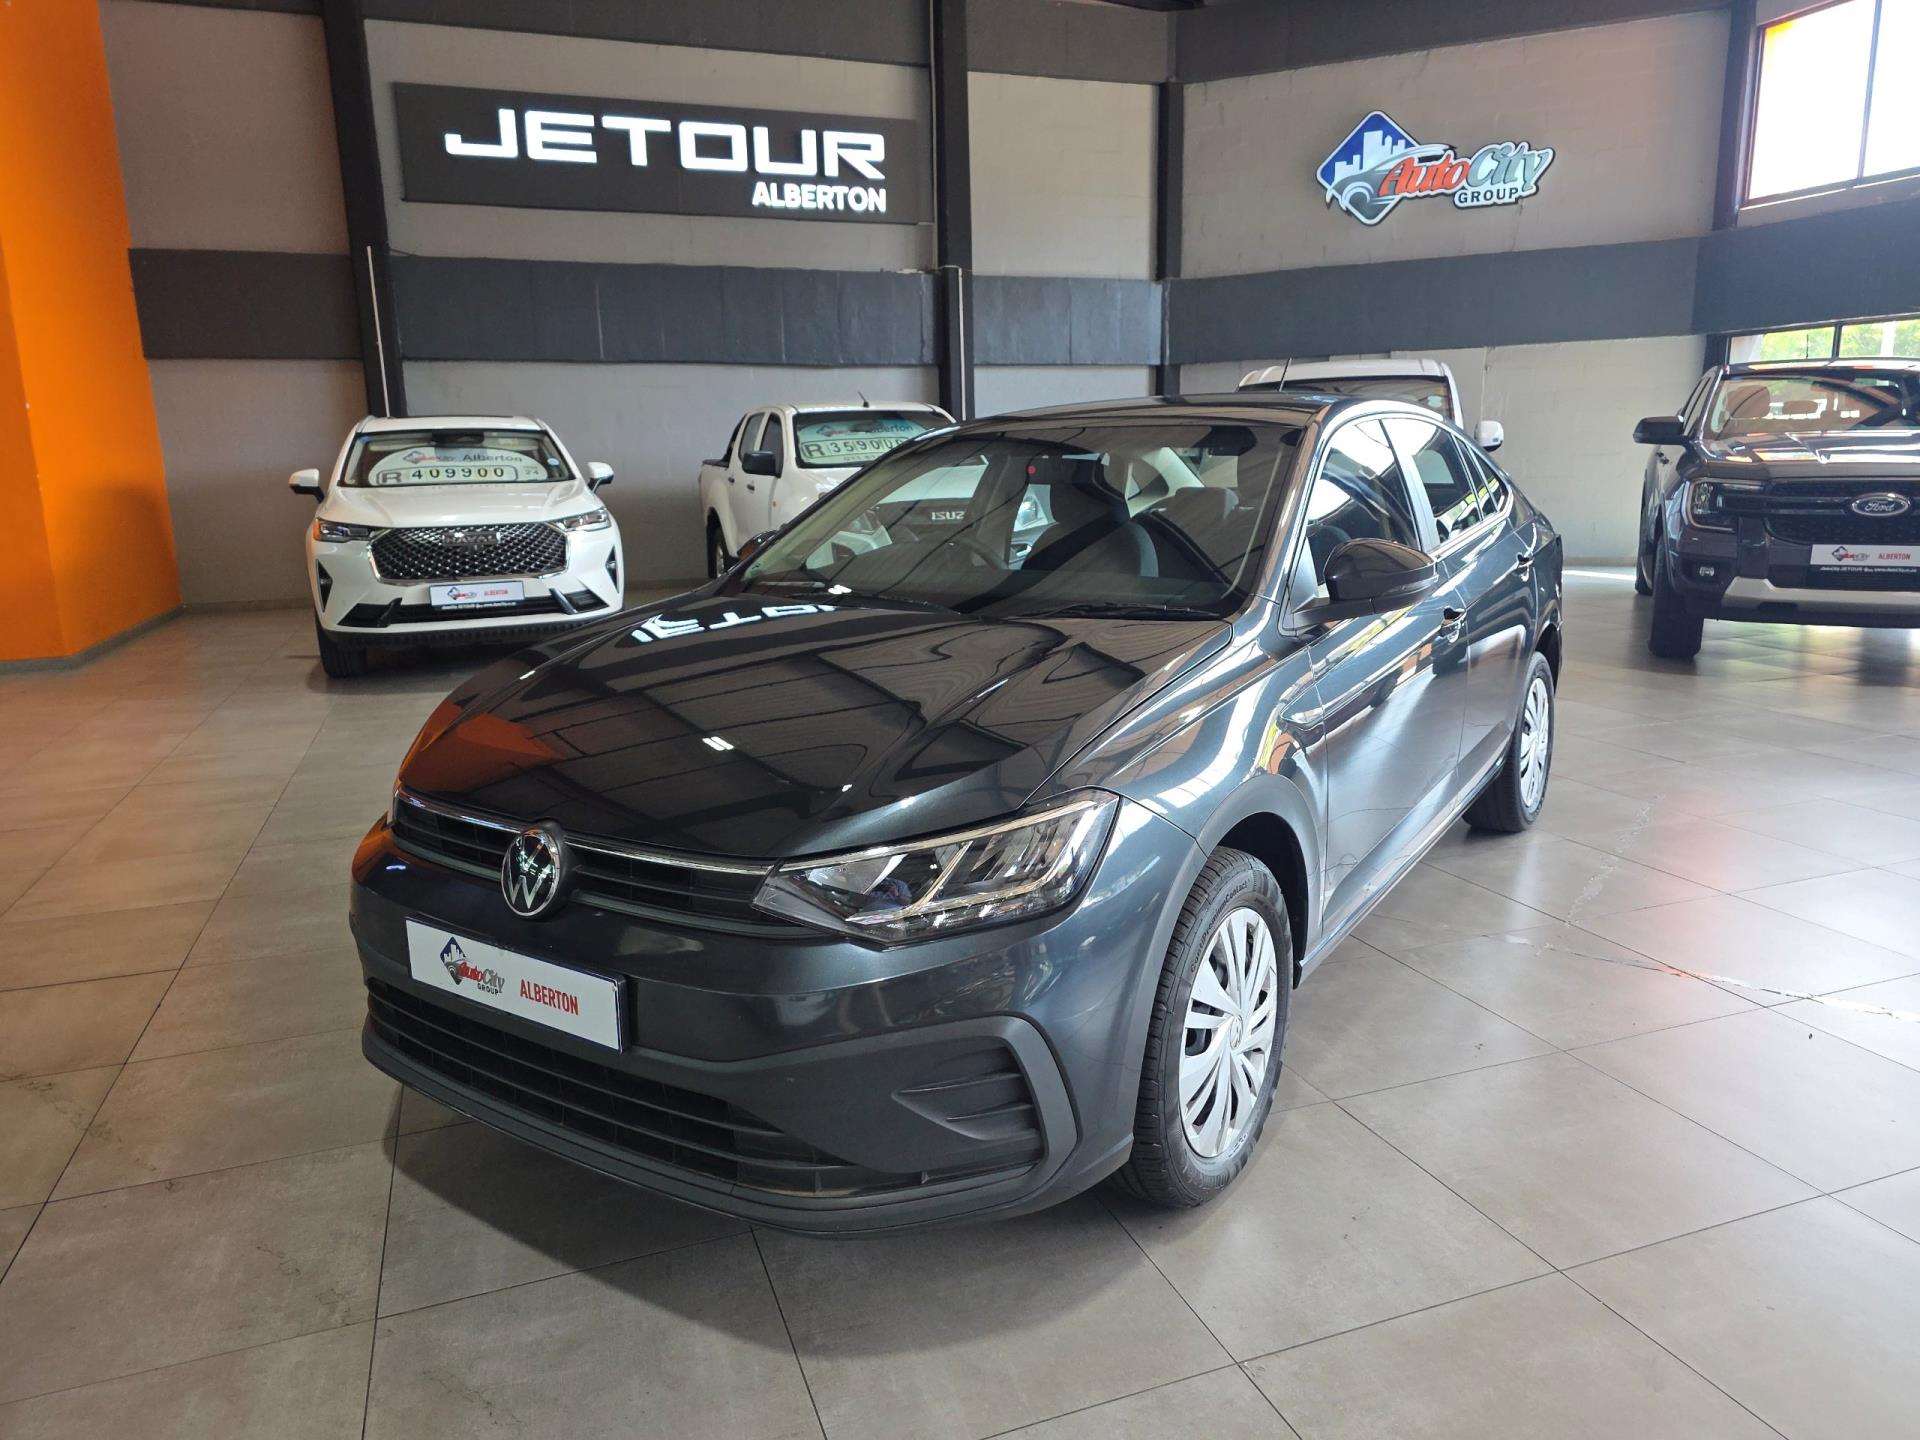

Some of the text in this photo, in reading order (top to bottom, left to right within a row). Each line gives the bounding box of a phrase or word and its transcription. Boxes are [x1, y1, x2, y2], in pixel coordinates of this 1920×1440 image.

[444, 107, 886, 180] JETOUR
[1378, 144, 1551, 196] AutoCity
[751, 181, 887, 213] ALBERTON
[1458, 187, 1519, 204] GROUP
[462, 452, 523, 463] Alberton
[804, 443, 825, 457] R
[381, 467, 505, 483] R 409900
[1864, 501, 1896, 512] Ford
[931, 510, 965, 520] ISUZ
[1878, 552, 1911, 560] ALBERTON
[457, 961, 579, 1016] AutoCity ALBERTON
[477, 982, 499, 996] GROUP
